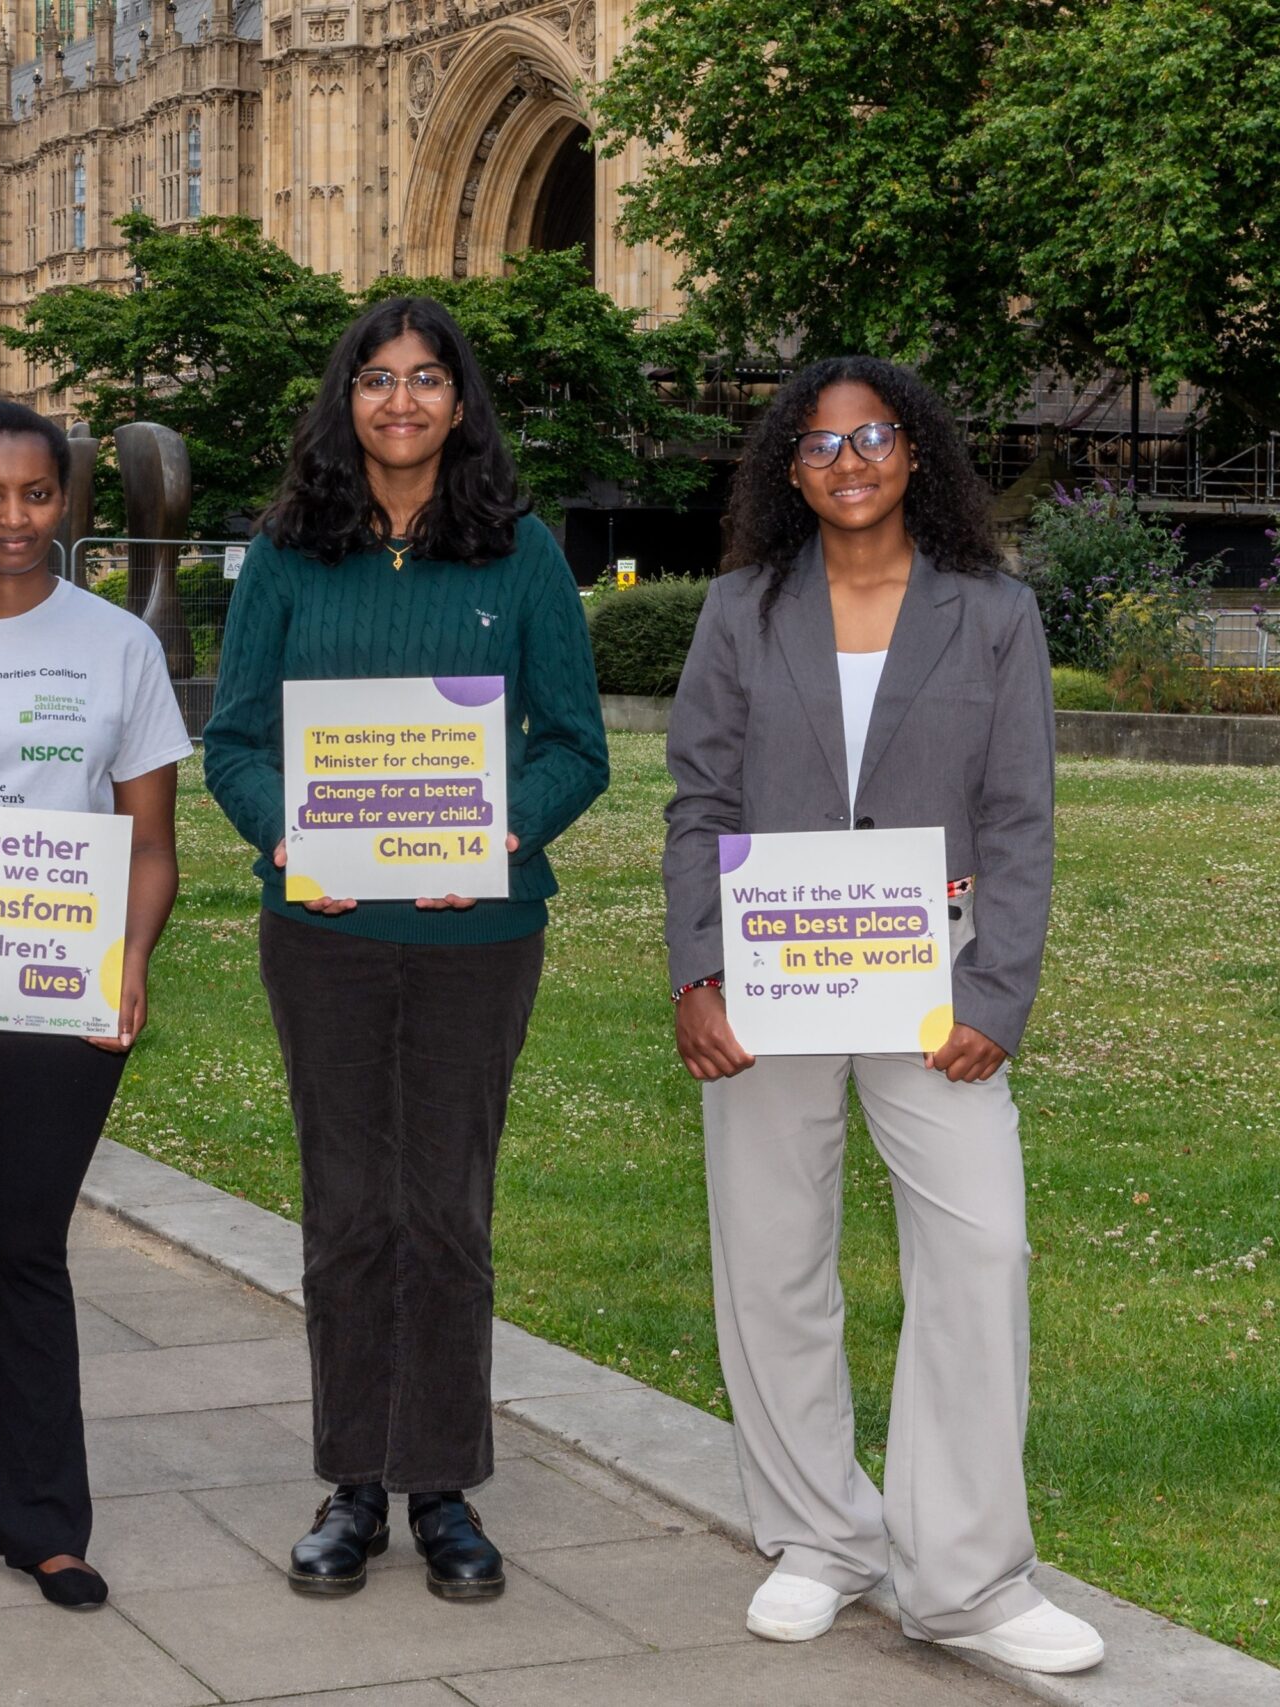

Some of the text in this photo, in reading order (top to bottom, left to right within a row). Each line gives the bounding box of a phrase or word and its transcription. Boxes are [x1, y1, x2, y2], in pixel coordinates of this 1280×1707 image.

[39, 667, 87, 681] Coalition
[34, 694, 86, 705] Believe in
[34, 703, 80, 712] children
[34, 712, 87, 723] Barnardo's
[344, 730, 395, 746] asking
[401, 730, 426, 743] the
[431, 729, 477, 743] Prime
[20, 746, 84, 763] NSPCC
[314, 754, 475, 769] Minister for change.
[314, 784, 476, 801] Change for a better
[304, 810, 354, 824] future
[359, 809, 382, 823] for
[387, 811, 435, 825] every
[379, 836, 484, 859] Chan, 14
[3, 864, 88, 885] we can
[732, 884, 922, 904] What if the UK was
[746, 911, 923, 938] the best place
[785, 944, 933, 967] in the world
[24, 968, 81, 993] lives
[745, 978, 859, 1000] to grow up?
[49, 1018, 82, 1028] NSPCC
